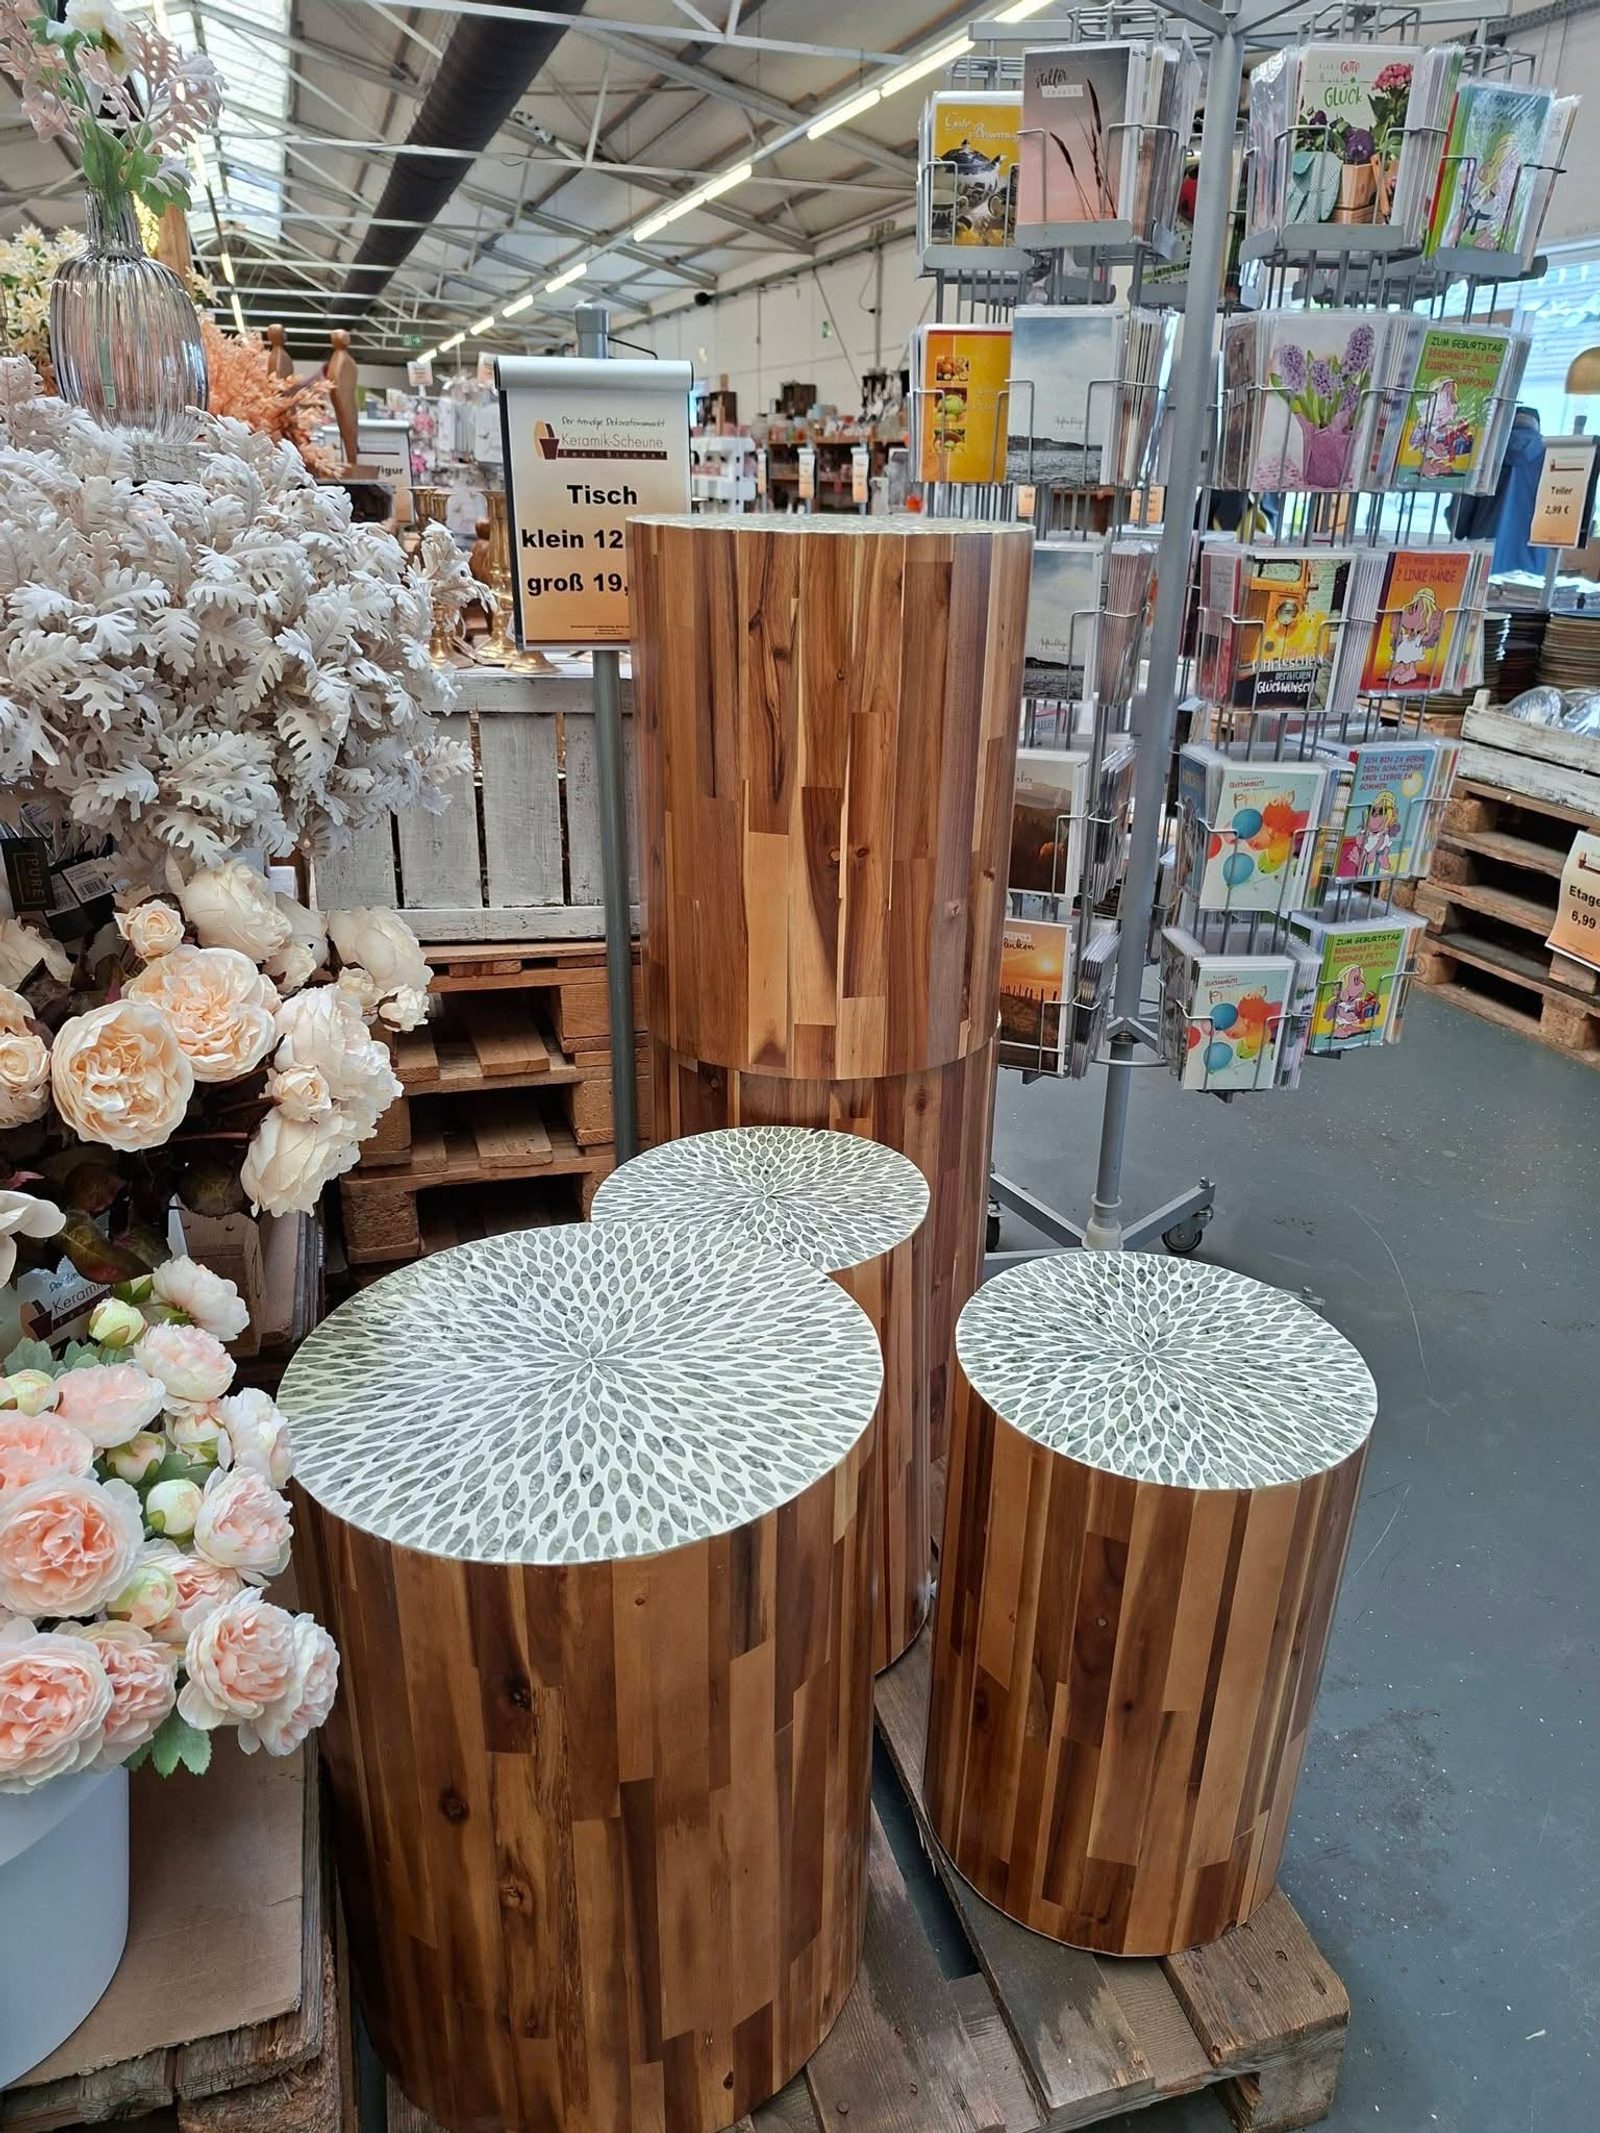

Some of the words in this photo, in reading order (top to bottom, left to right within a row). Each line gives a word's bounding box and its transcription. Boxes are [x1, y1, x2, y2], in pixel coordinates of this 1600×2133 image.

[1431, 336, 1449, 346] ZUM
[1452, 339, 1503, 352] GEBURTSTAG
[561, 433, 664, 448] Keramik-Scheune
[566, 485, 637, 504] Tisch
[1551, 486, 1573, 495] Teller
[1545, 505, 1562, 515] 2,99
[521, 529, 584, 548] klein
[594, 529, 624, 549] 12
[527, 573, 584, 597] groß
[593, 573, 629, 597] 19,
[27, 857, 44, 898] PURE
[1572, 910, 1596, 929] 6,99
[1355, 934, 1401, 944] GEBURTSTAG
[53, 1284, 104, 1314] Kerami
